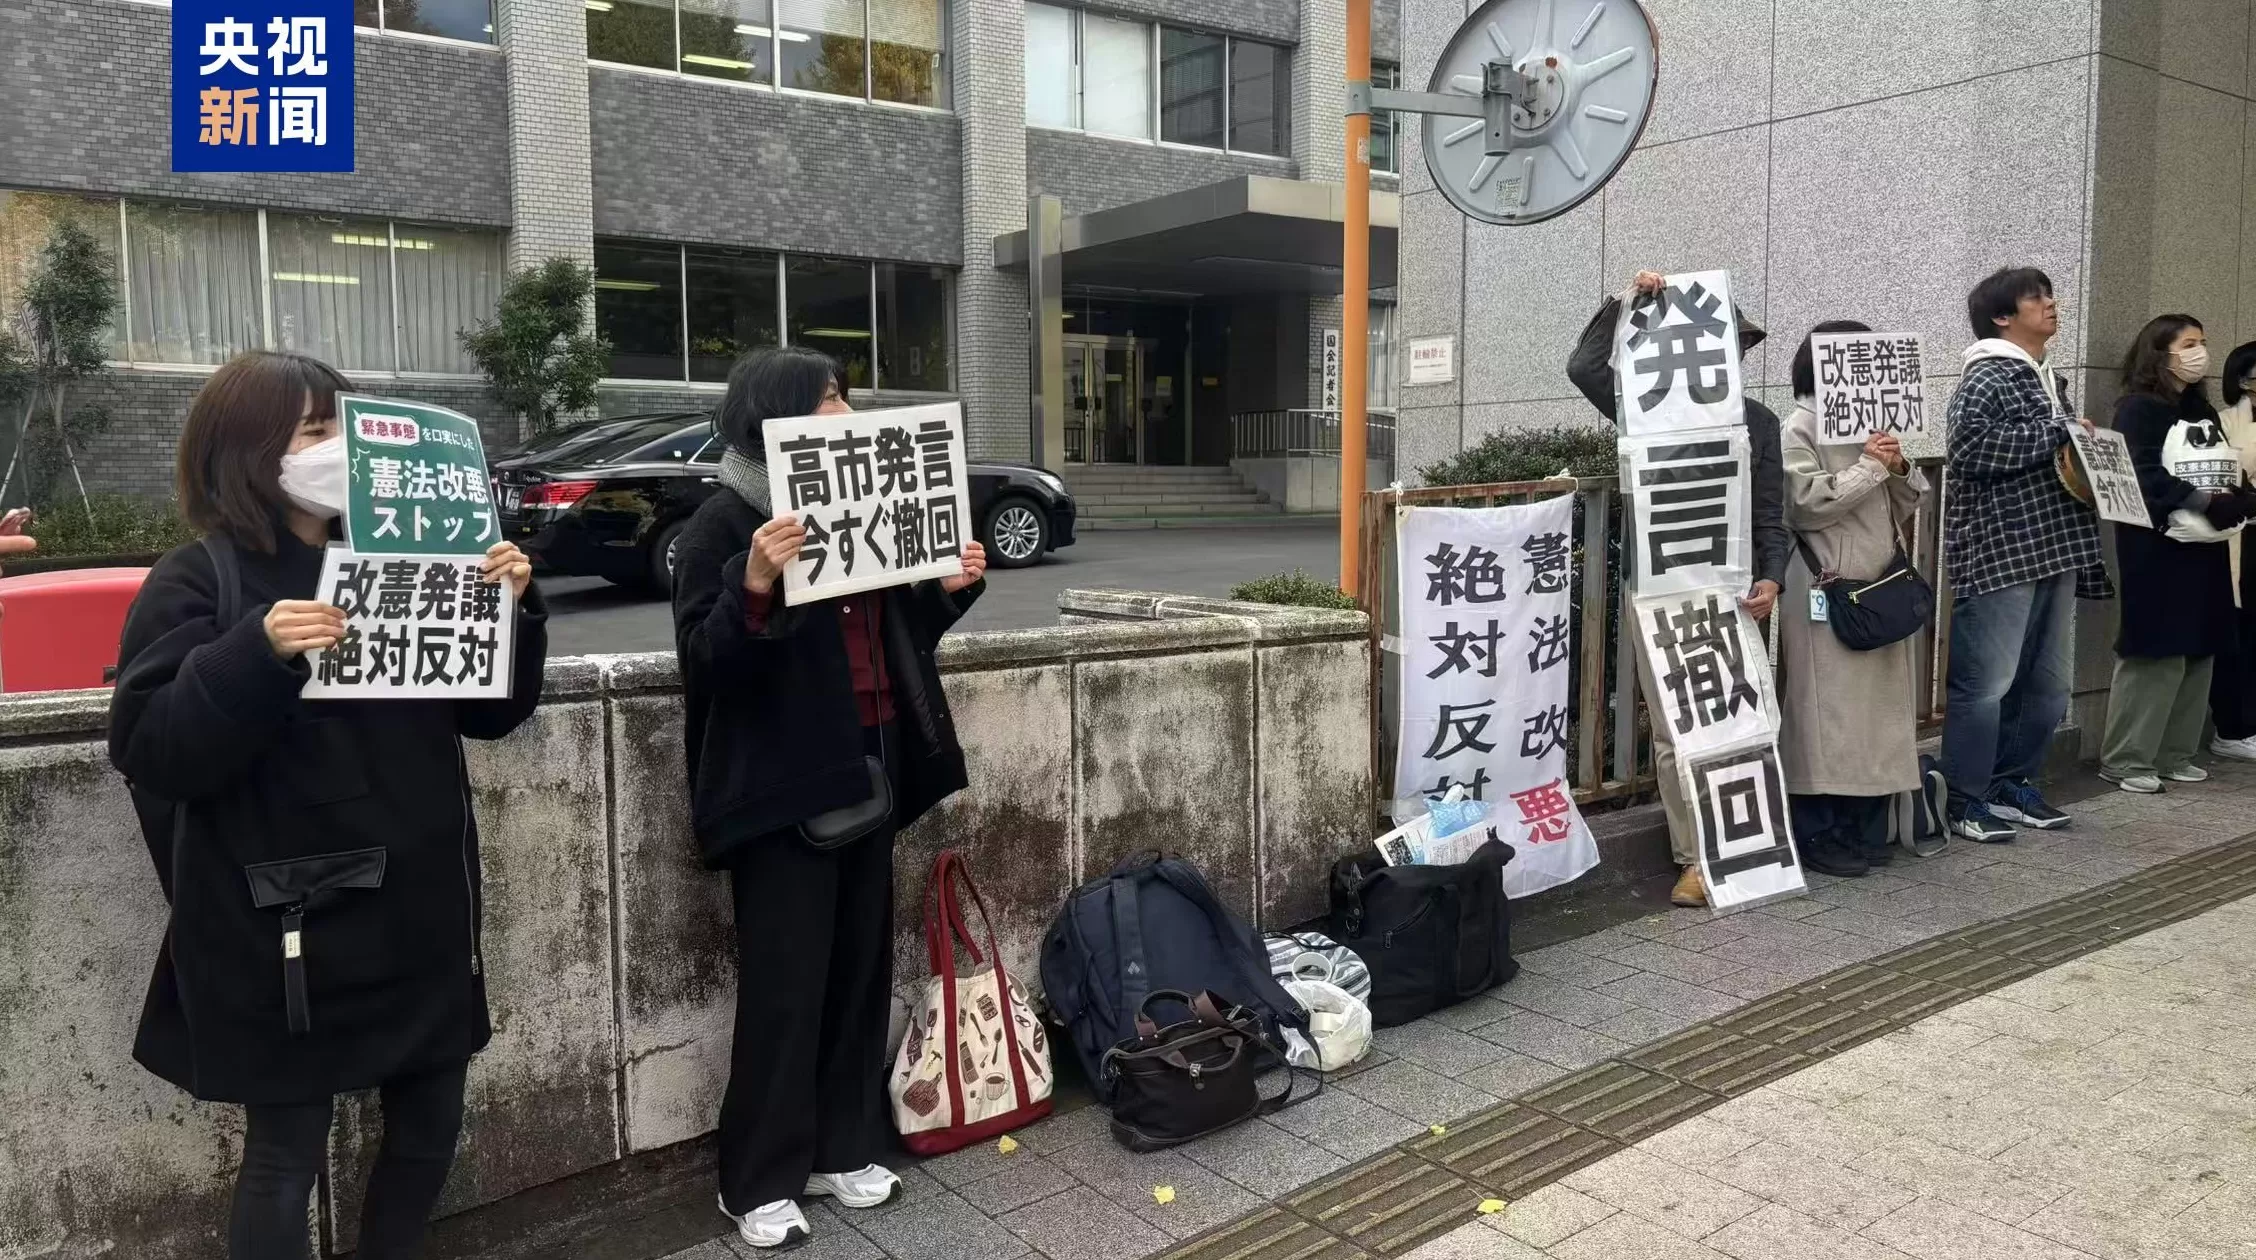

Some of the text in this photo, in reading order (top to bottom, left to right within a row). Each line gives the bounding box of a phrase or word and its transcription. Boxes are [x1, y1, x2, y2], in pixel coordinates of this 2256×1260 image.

[1818, 338, 1922, 388] 改憲発議
[361, 419, 475, 451] 緊急事態 を口実にした
[1824, 386, 1924, 438] 絶対反対
[369, 457, 488, 503] 憲法改悪
[780, 420, 954, 510] 高市発言
[372, 505, 492, 542] ストップ
[799, 494, 961, 586] 今すぐ撤回
[333, 559, 502, 623] 改憲発議
[1626, 280, 1796, 886] 発言撤回
[318, 624, 499, 687] 絶対反対
[1509, 532, 1570, 844] 憲法改悪
